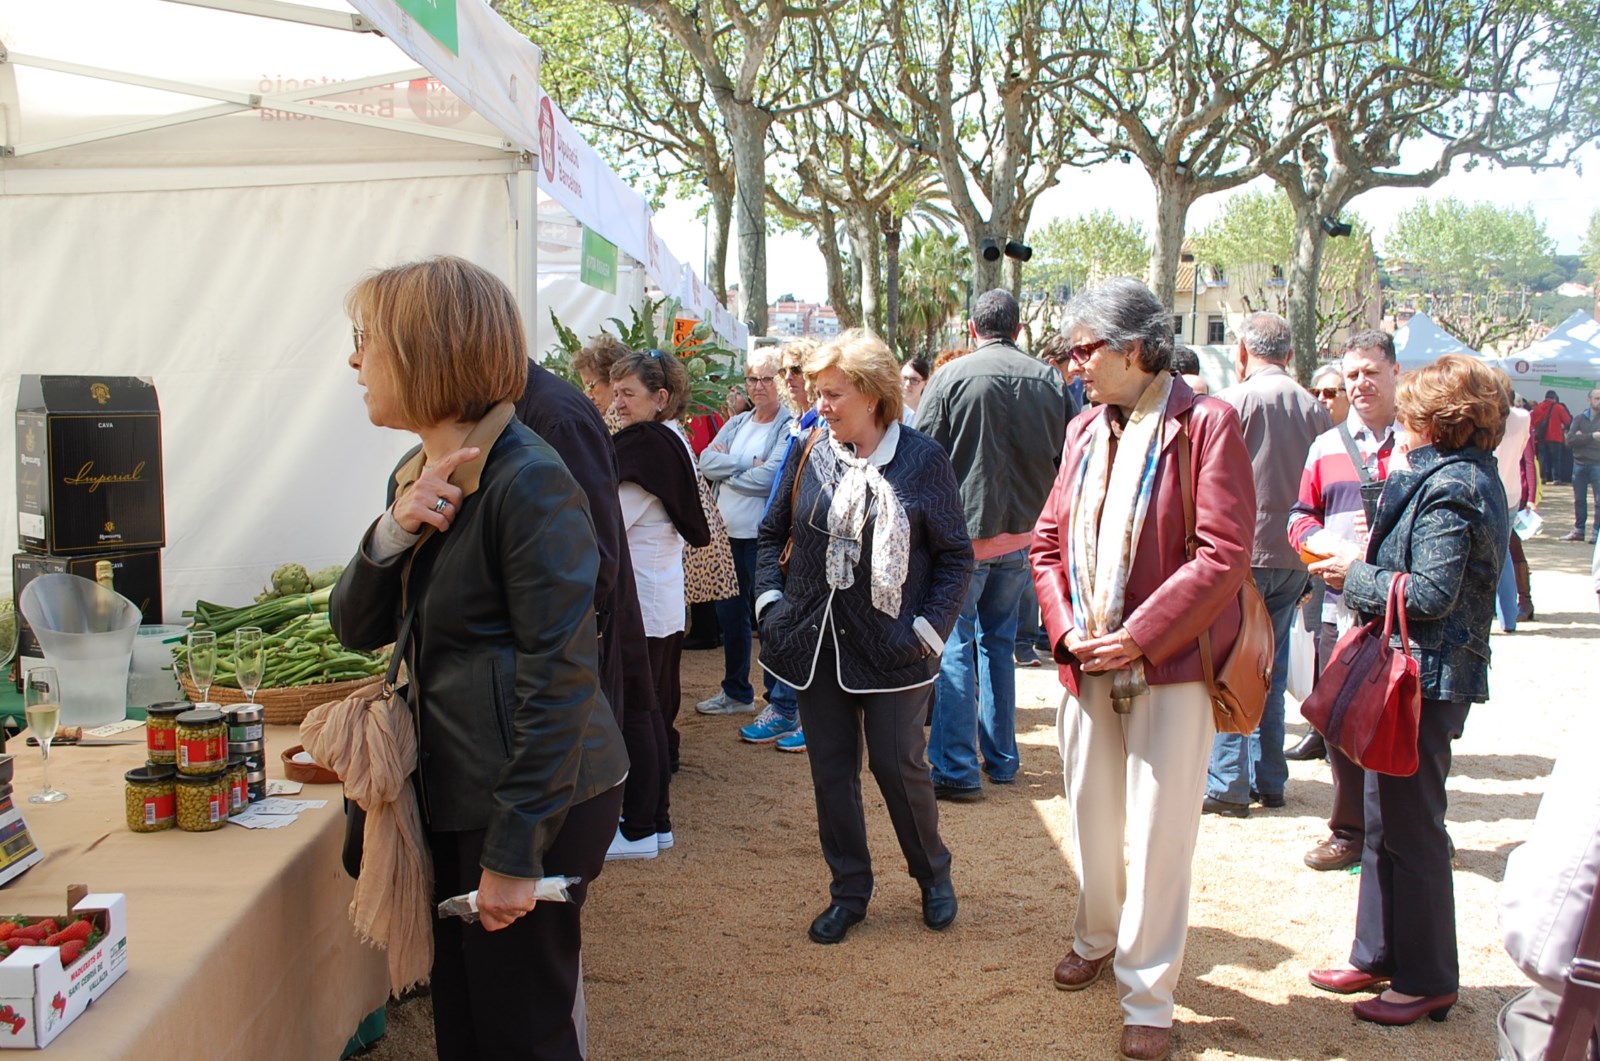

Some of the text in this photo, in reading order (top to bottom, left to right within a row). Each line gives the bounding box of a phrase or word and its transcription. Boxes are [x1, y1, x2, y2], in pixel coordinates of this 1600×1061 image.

[556, 129, 580, 169] Diputació
[558, 160, 583, 199] Barcelona
[63, 460, 146, 493] Imperial
[68, 981, 80, 998] SANT
